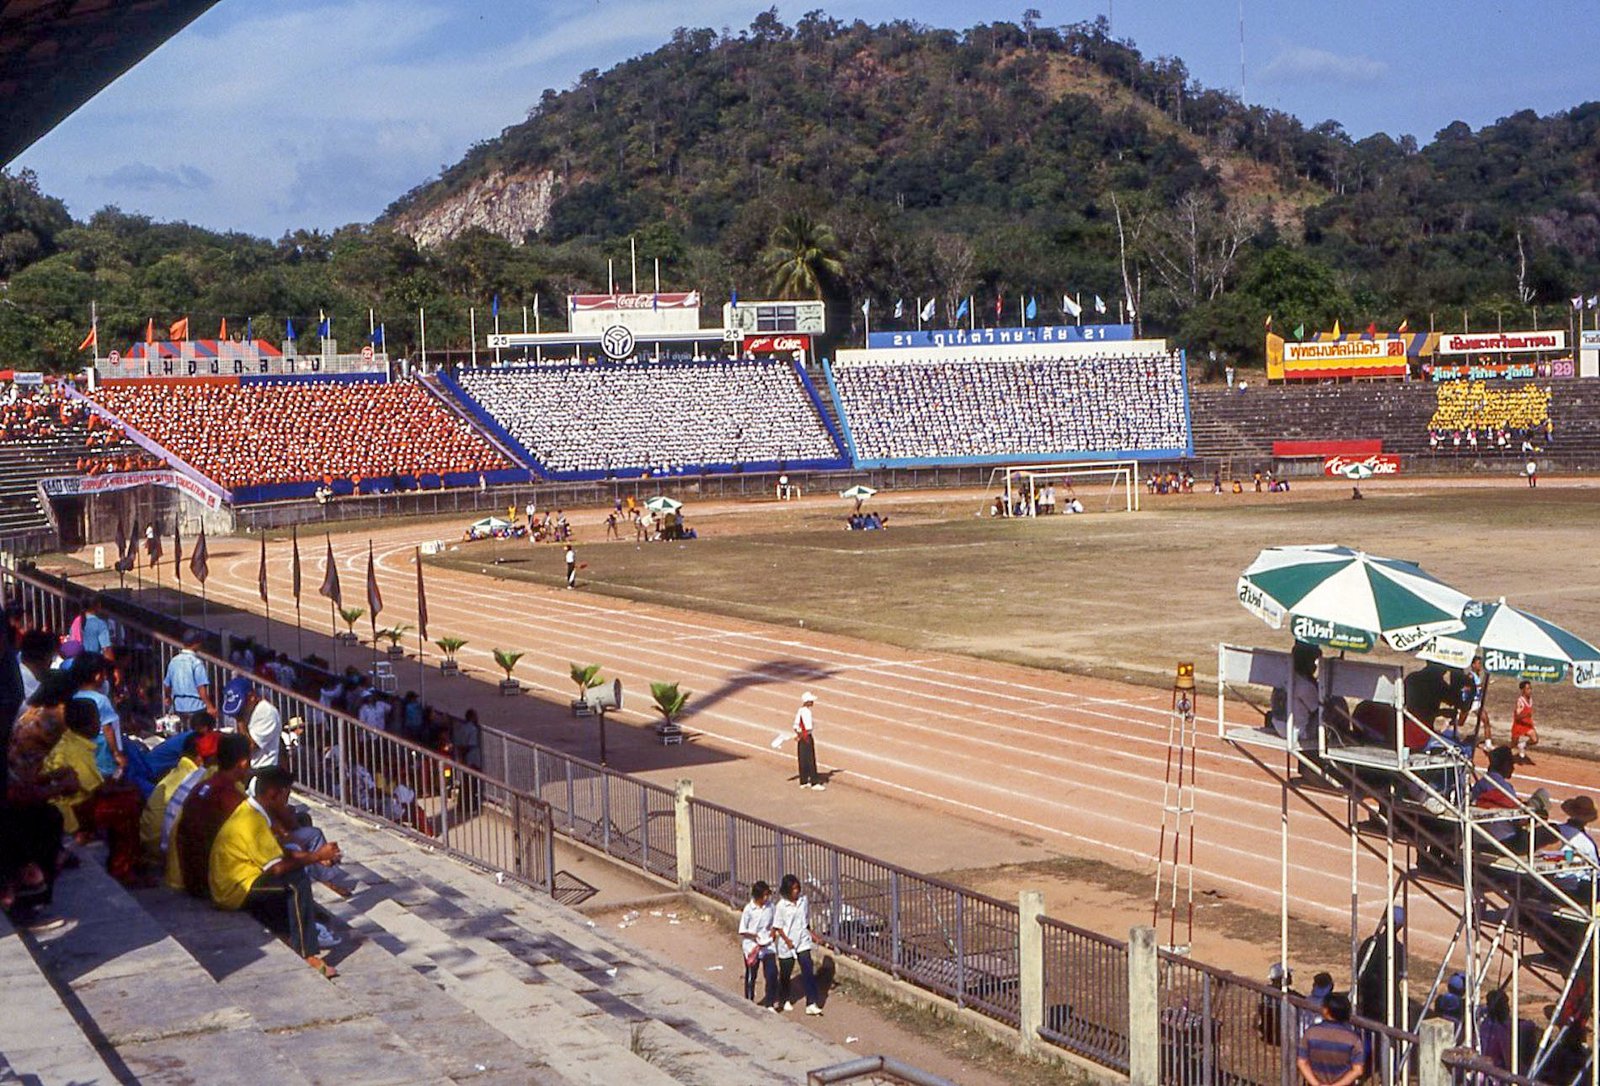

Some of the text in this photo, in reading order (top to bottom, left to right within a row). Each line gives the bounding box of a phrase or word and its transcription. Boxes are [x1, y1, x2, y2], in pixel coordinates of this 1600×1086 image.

[726, 329, 739, 339] 25
[893, 334, 912, 345] 21
[1084, 328, 1105, 339] 21
[493, 336, 508, 346] 25
[1387, 341, 1404, 357] 20
